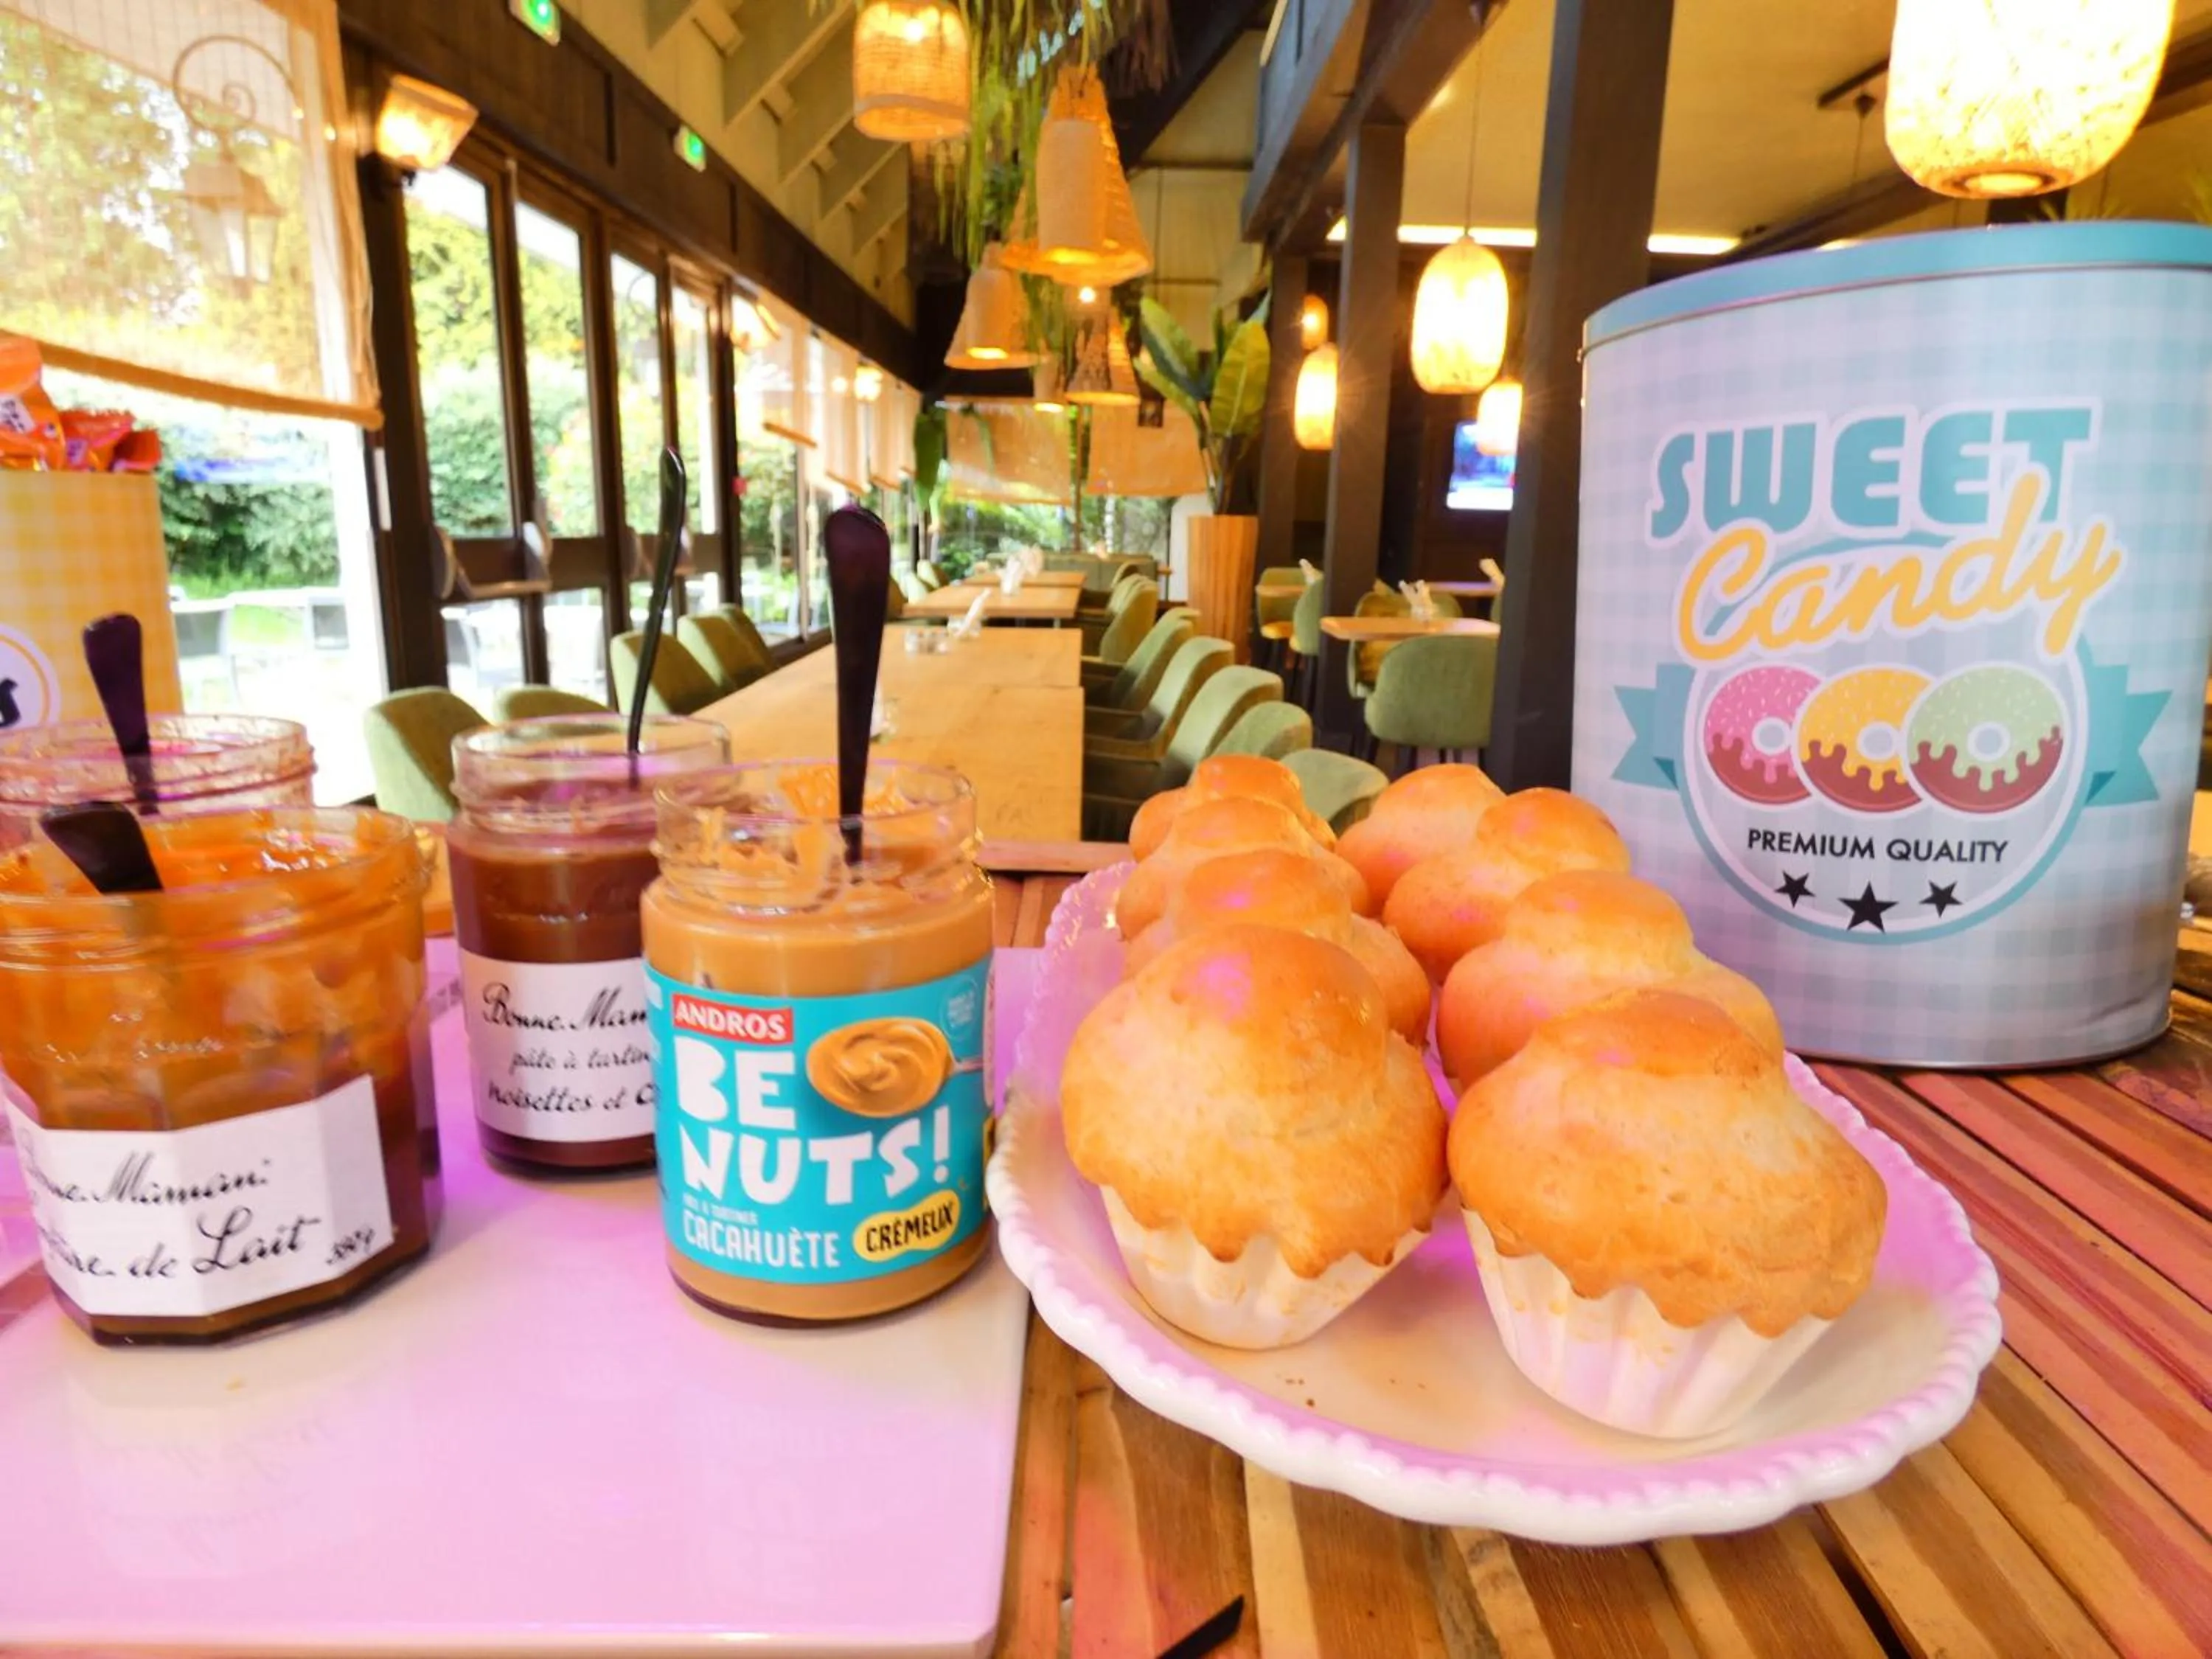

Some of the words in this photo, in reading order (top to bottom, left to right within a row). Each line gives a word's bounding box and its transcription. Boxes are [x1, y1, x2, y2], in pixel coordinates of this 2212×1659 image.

[1651, 407, 2093, 538] SWEET
[1678, 472, 2122, 661] Candy
[1747, 828, 1875, 860] PREMIUM
[1886, 838, 2009, 863] QUALITY
[483, 982, 565, 1030] Bonne
[675, 1000, 787, 1041] ANDROS
[603, 1086, 626, 1111] et
[674, 1034, 797, 1131] BE
[92, 1149, 270, 1207] Maman
[679, 1107, 950, 1206] NUTS!
[128, 1242, 177, 1279] de
[192, 1204, 321, 1274] Lait
[683, 1208, 841, 1269] CACAHUÈTE
